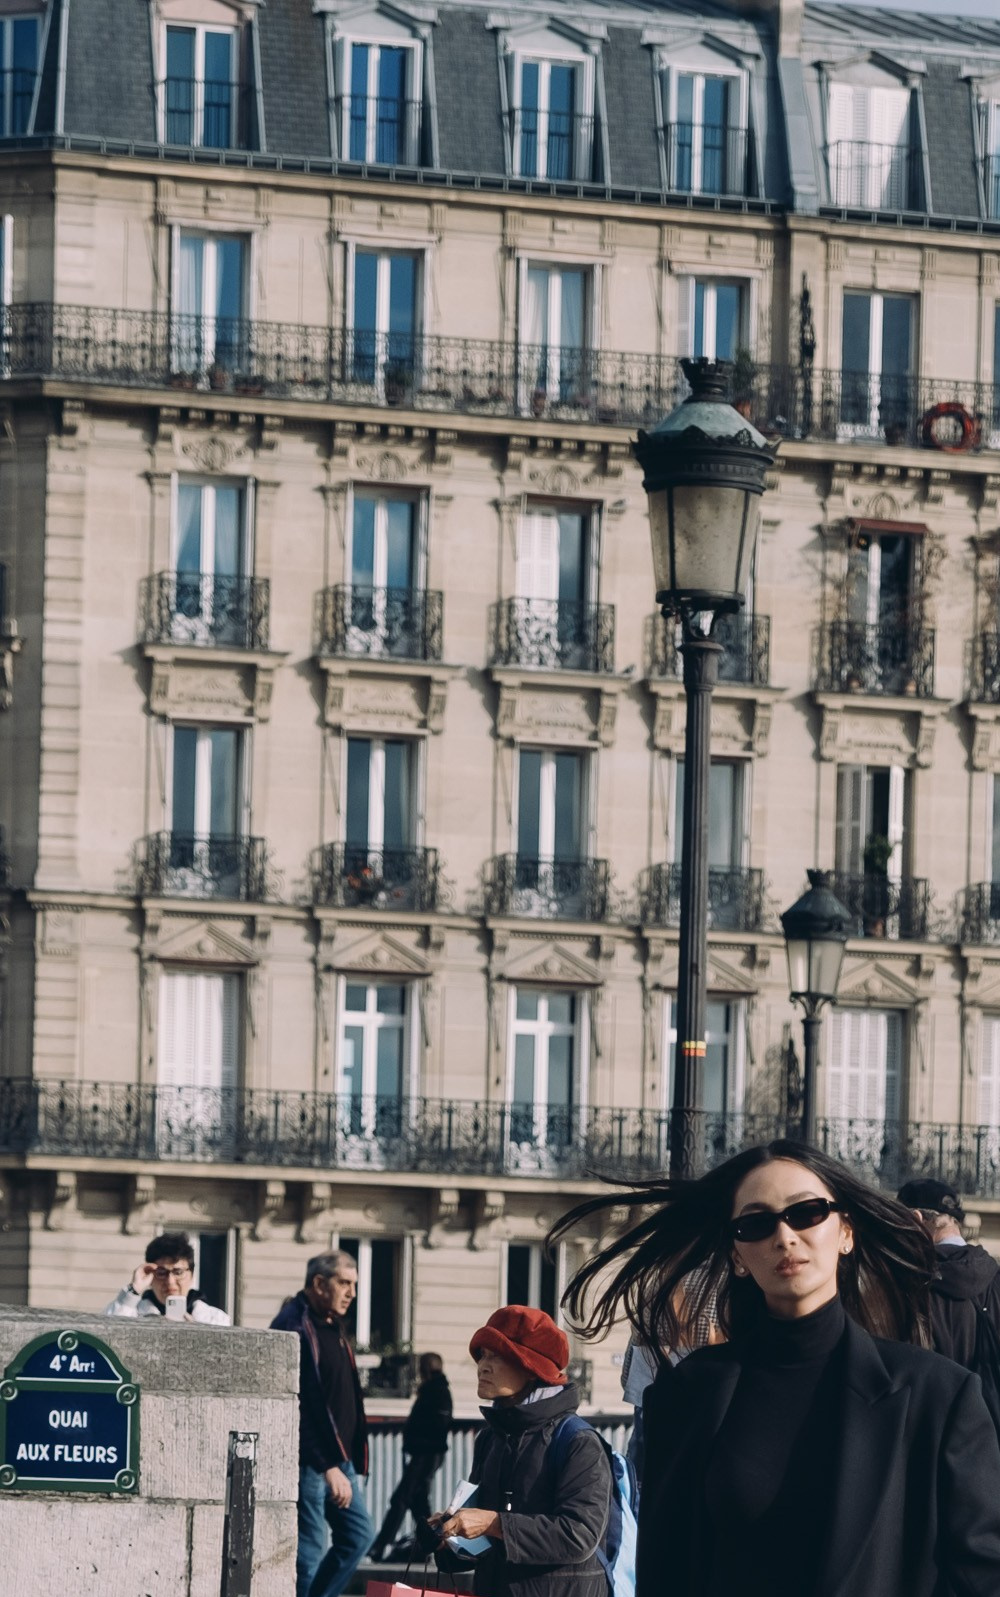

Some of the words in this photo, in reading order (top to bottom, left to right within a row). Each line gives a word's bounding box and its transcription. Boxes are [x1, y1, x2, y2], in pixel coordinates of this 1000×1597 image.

[48, 1409, 88, 1429] QUAI
[16, 1443, 50, 1461] AUX
[54, 1444, 118, 1464] FLEURS
